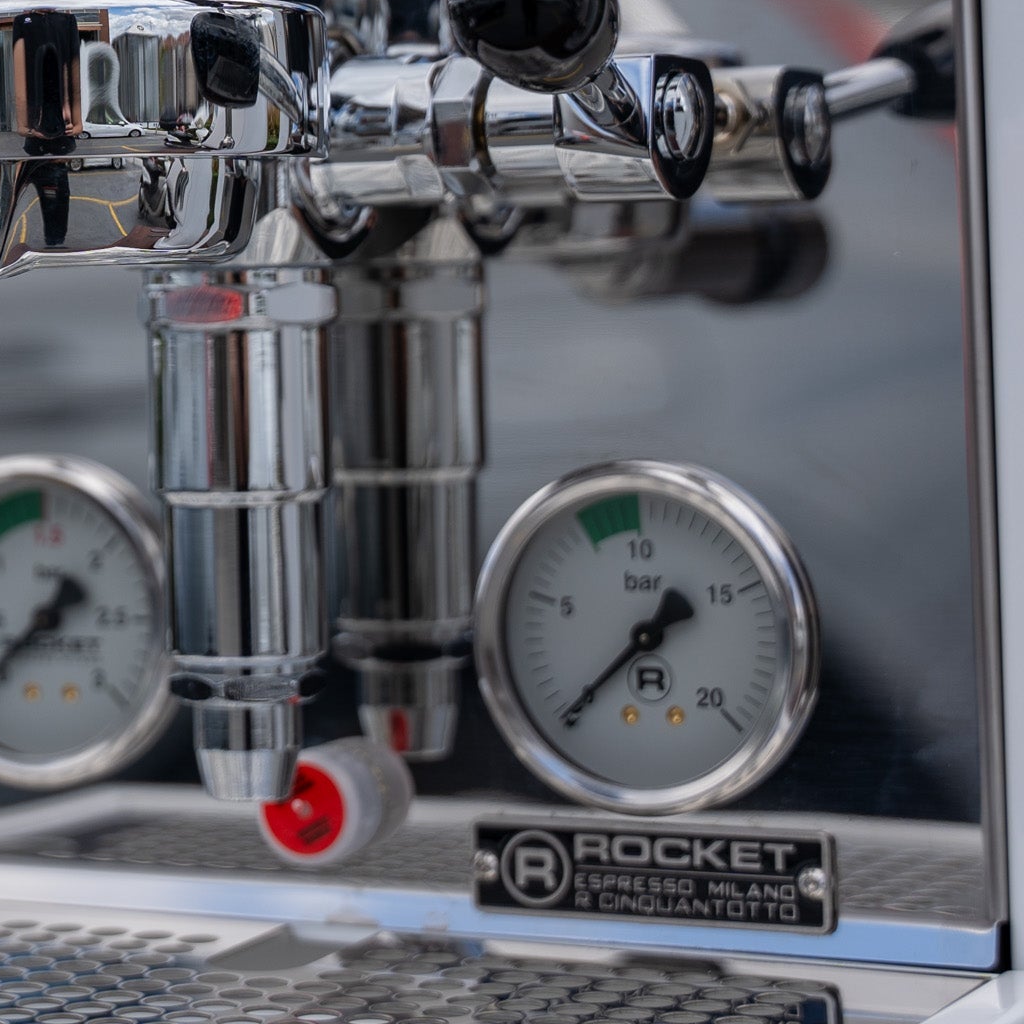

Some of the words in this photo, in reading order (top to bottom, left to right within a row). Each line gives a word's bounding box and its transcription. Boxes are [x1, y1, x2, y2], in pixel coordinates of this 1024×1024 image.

[628, 538, 653, 560] 10
[624, 572, 663, 593] bar
[707, 584, 733, 605] 15
[560, 597, 573, 617] 5
[637, 666, 664, 691] R
[696, 687, 723, 708] 20
[574, 833, 796, 871] ROCKET
[515, 846, 558, 890] R
[575, 873, 695, 895] ESPRESSO
[708, 880, 796, 902] MILANO
[574, 891, 592, 910] R
[598, 893, 799, 922] CINQUANTOTTO
